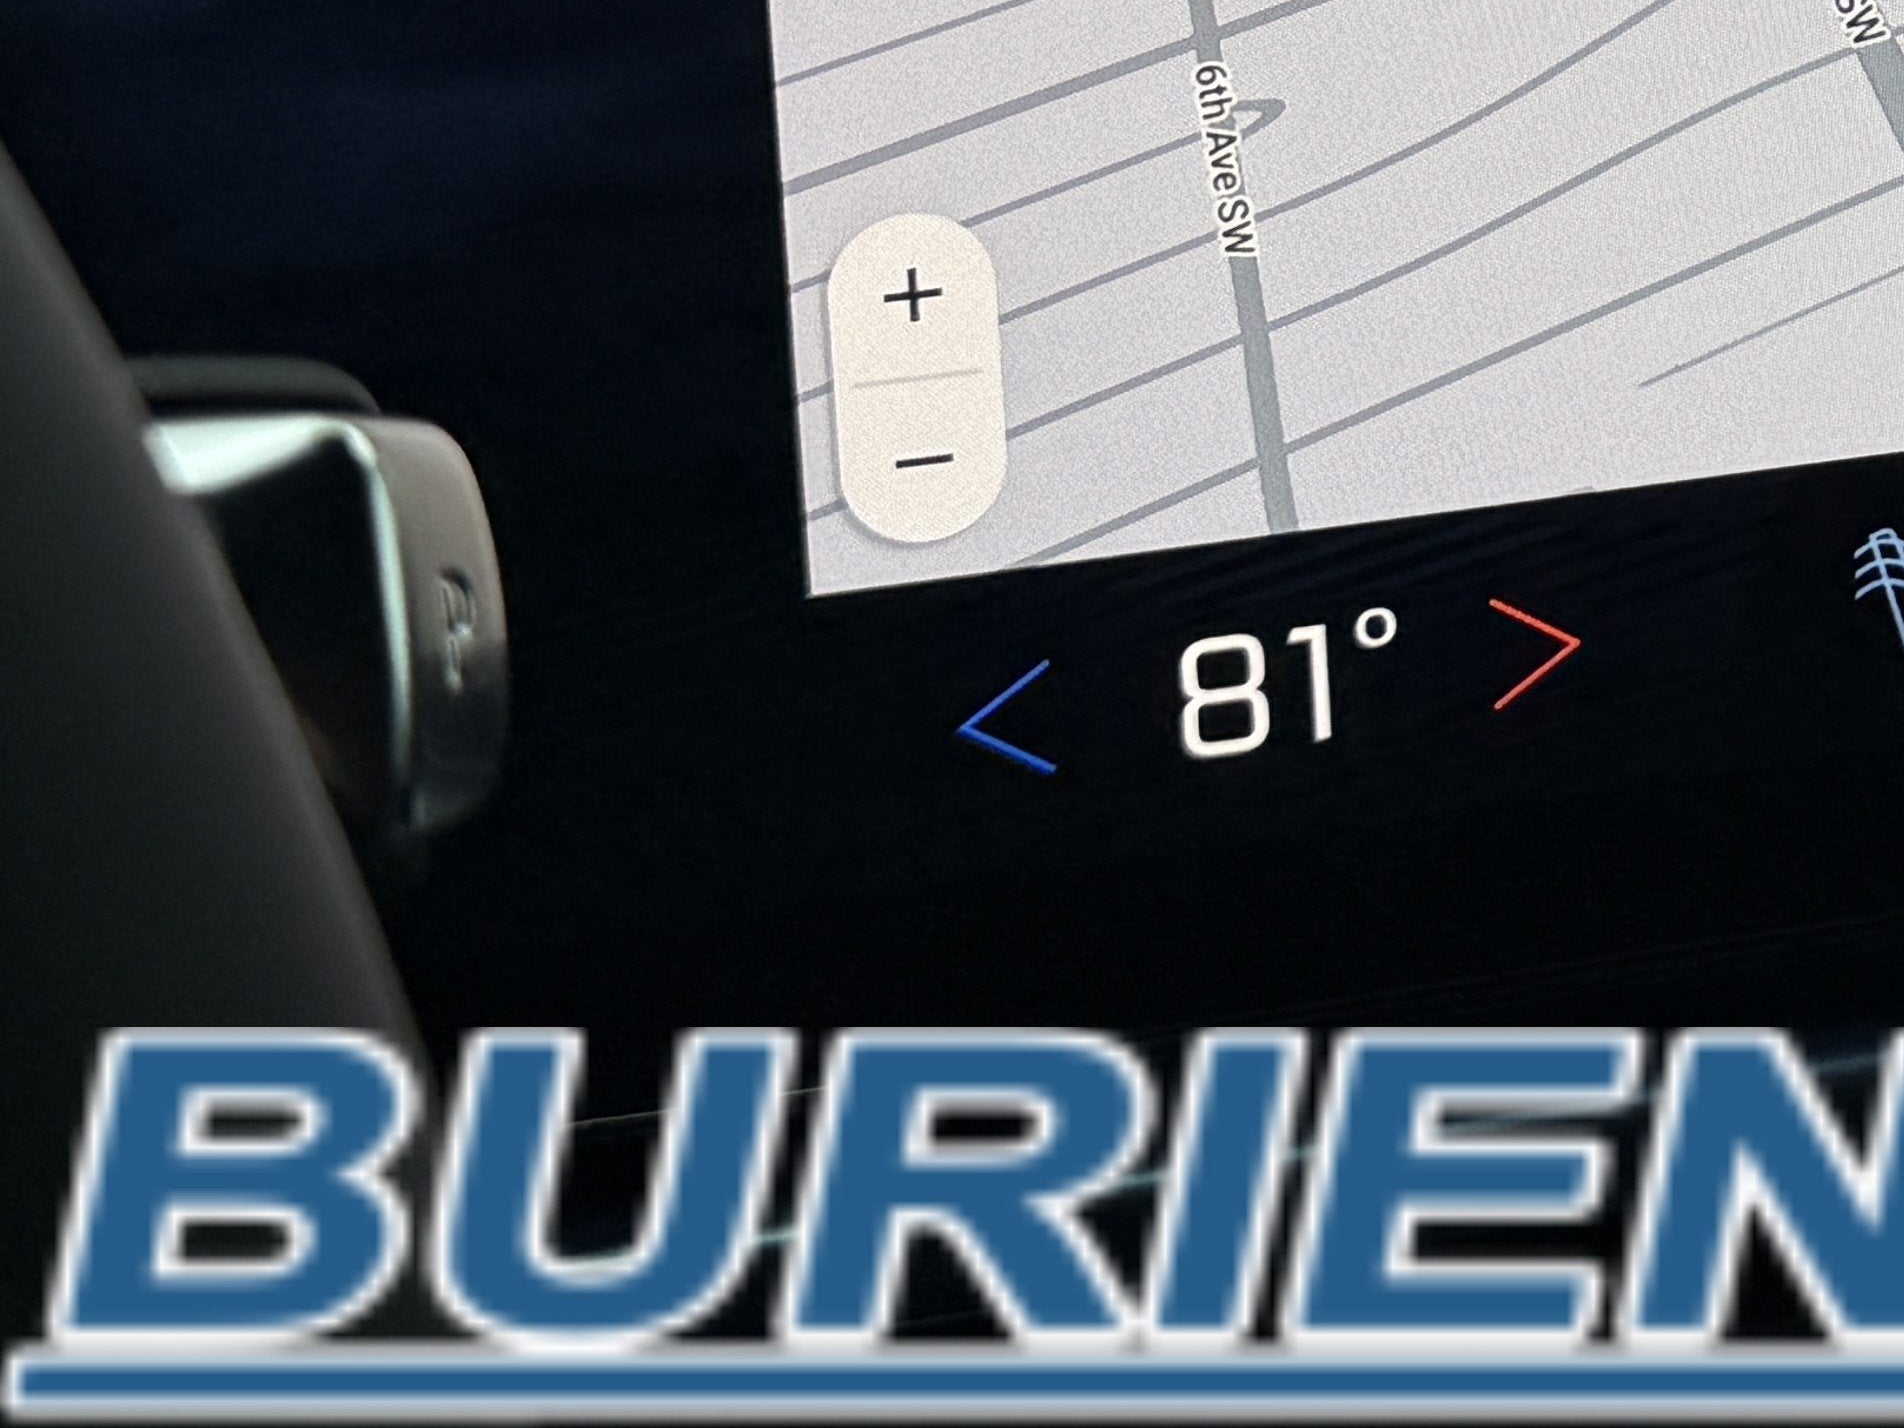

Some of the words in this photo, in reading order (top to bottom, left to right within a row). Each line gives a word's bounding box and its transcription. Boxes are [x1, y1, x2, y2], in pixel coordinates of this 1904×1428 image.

[1195, 65, 1232, 120] 6th
[1206, 132, 1237, 191] Ave
[1217, 199, 1255, 253] SW
